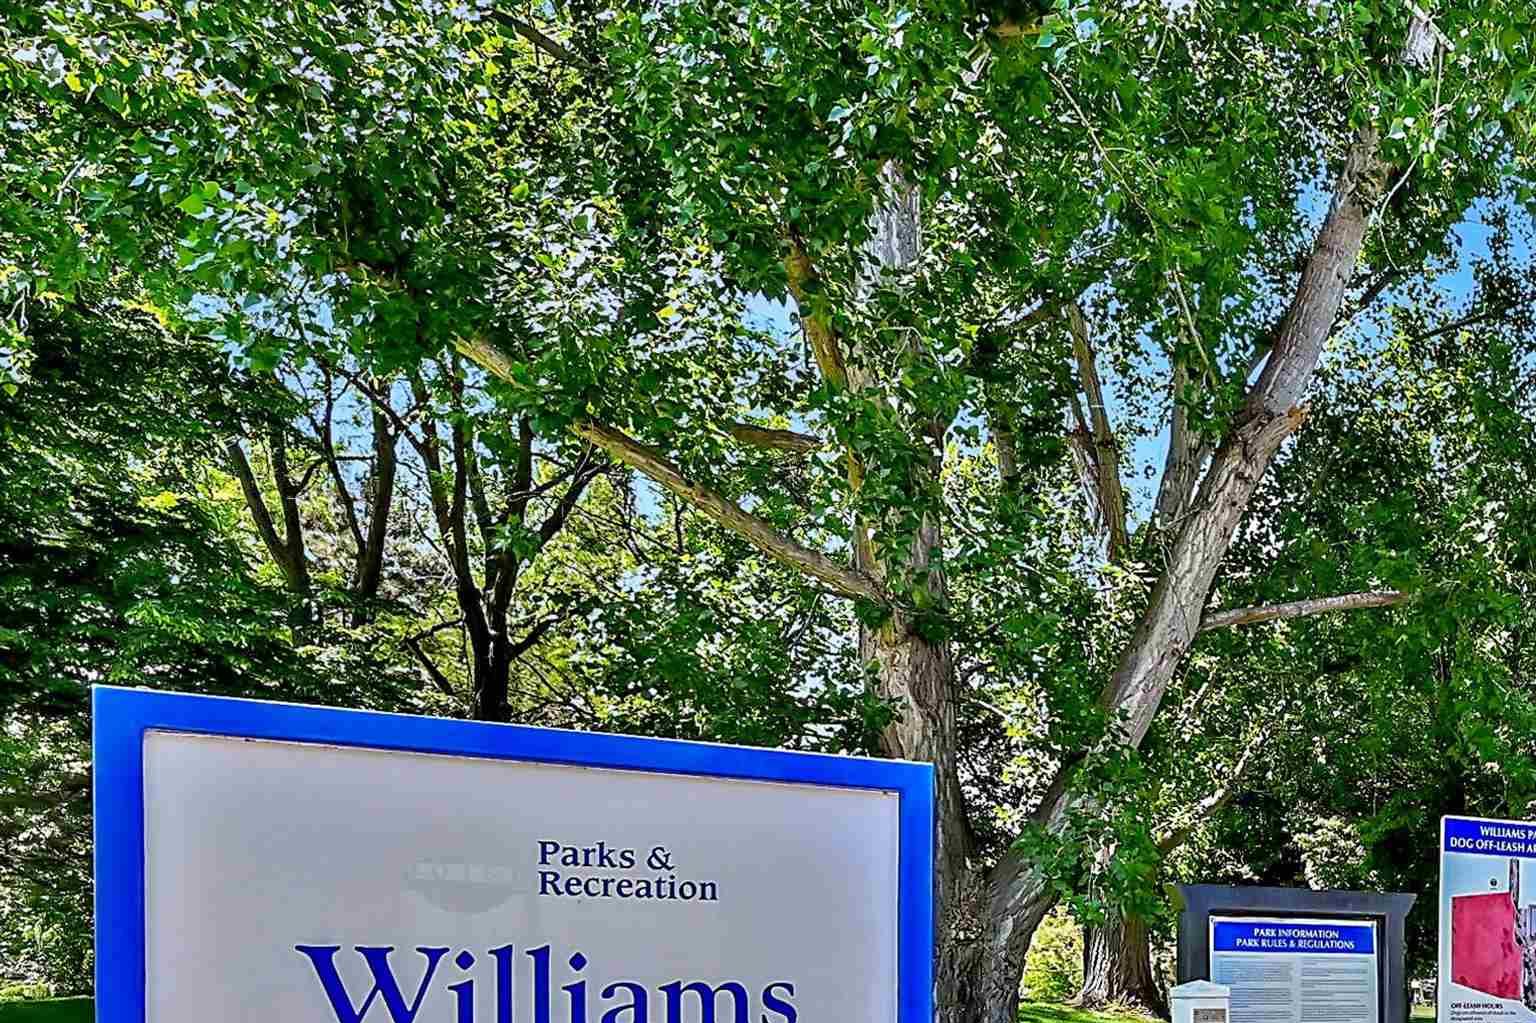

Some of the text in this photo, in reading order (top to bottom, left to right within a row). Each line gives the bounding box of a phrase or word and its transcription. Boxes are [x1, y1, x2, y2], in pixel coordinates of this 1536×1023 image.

[1479, 825, 1526, 839] WILLIAMS
[1450, 837, 1474, 849] DOG
[1475, 839, 1525, 852] OFF-LEASH
[537, 840, 636, 869] Parks
[646, 846, 676, 872] &
[537, 870, 718, 901] Recreation
[1253, 927, 1339, 939] PARK INFORMATION
[1236, 938, 1355, 949] PARK RULES & REGULATIONS
